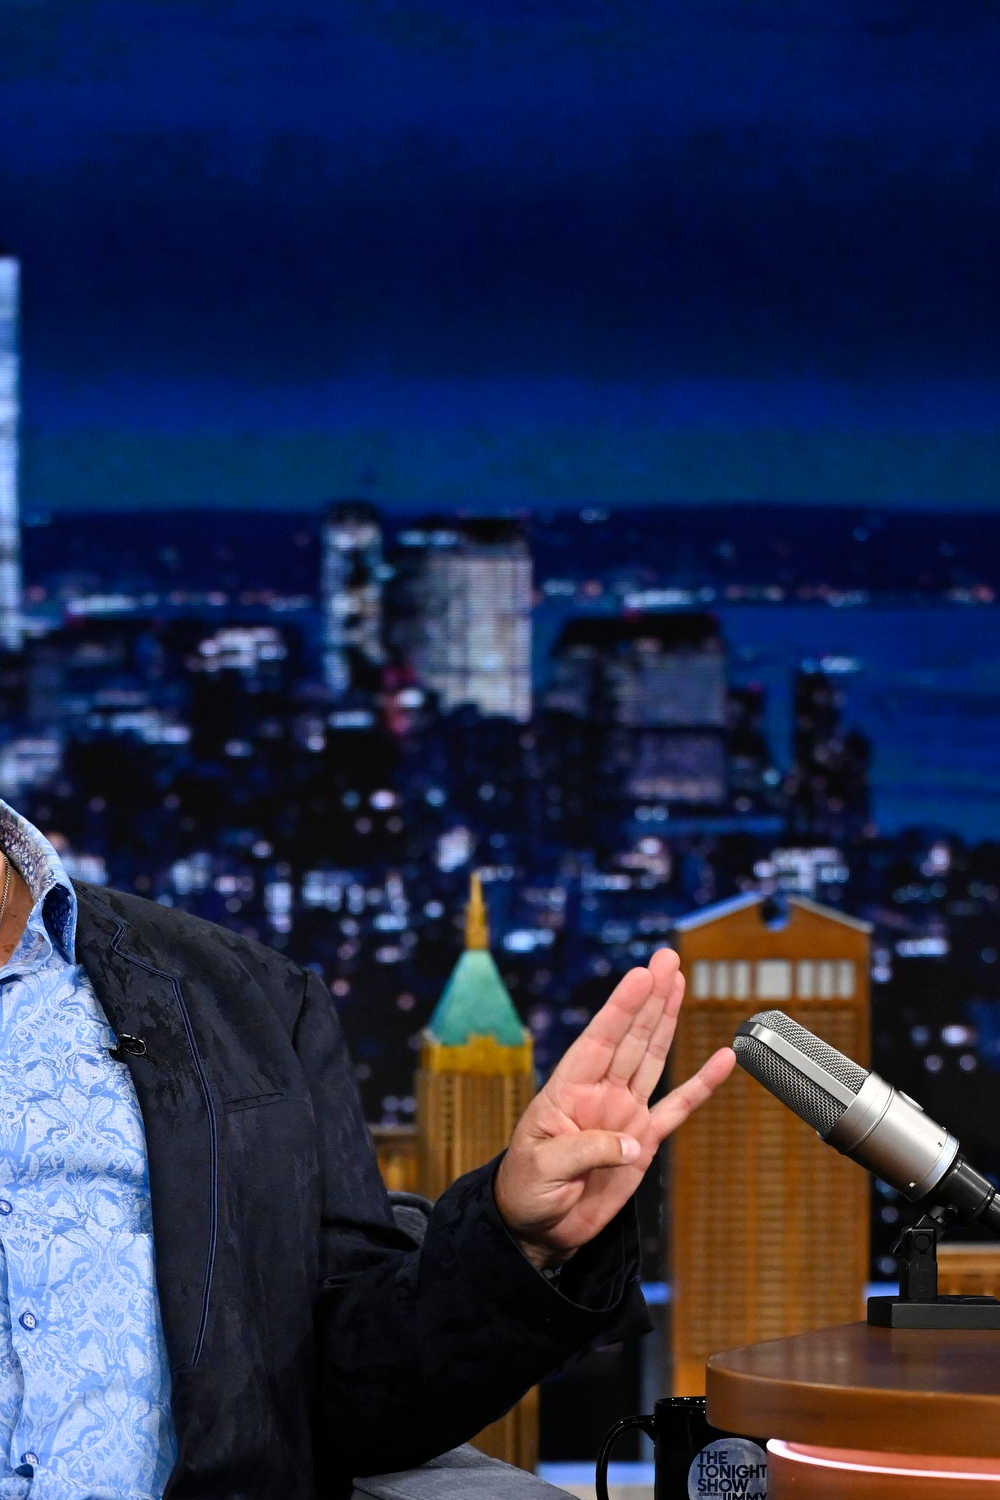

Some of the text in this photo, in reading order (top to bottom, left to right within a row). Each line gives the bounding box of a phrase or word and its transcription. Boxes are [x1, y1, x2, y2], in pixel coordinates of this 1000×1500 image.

[699, 1451, 728, 1464] THE
[697, 1464, 767, 1478] TONIGHT
[697, 1478, 749, 1492] SHOW
